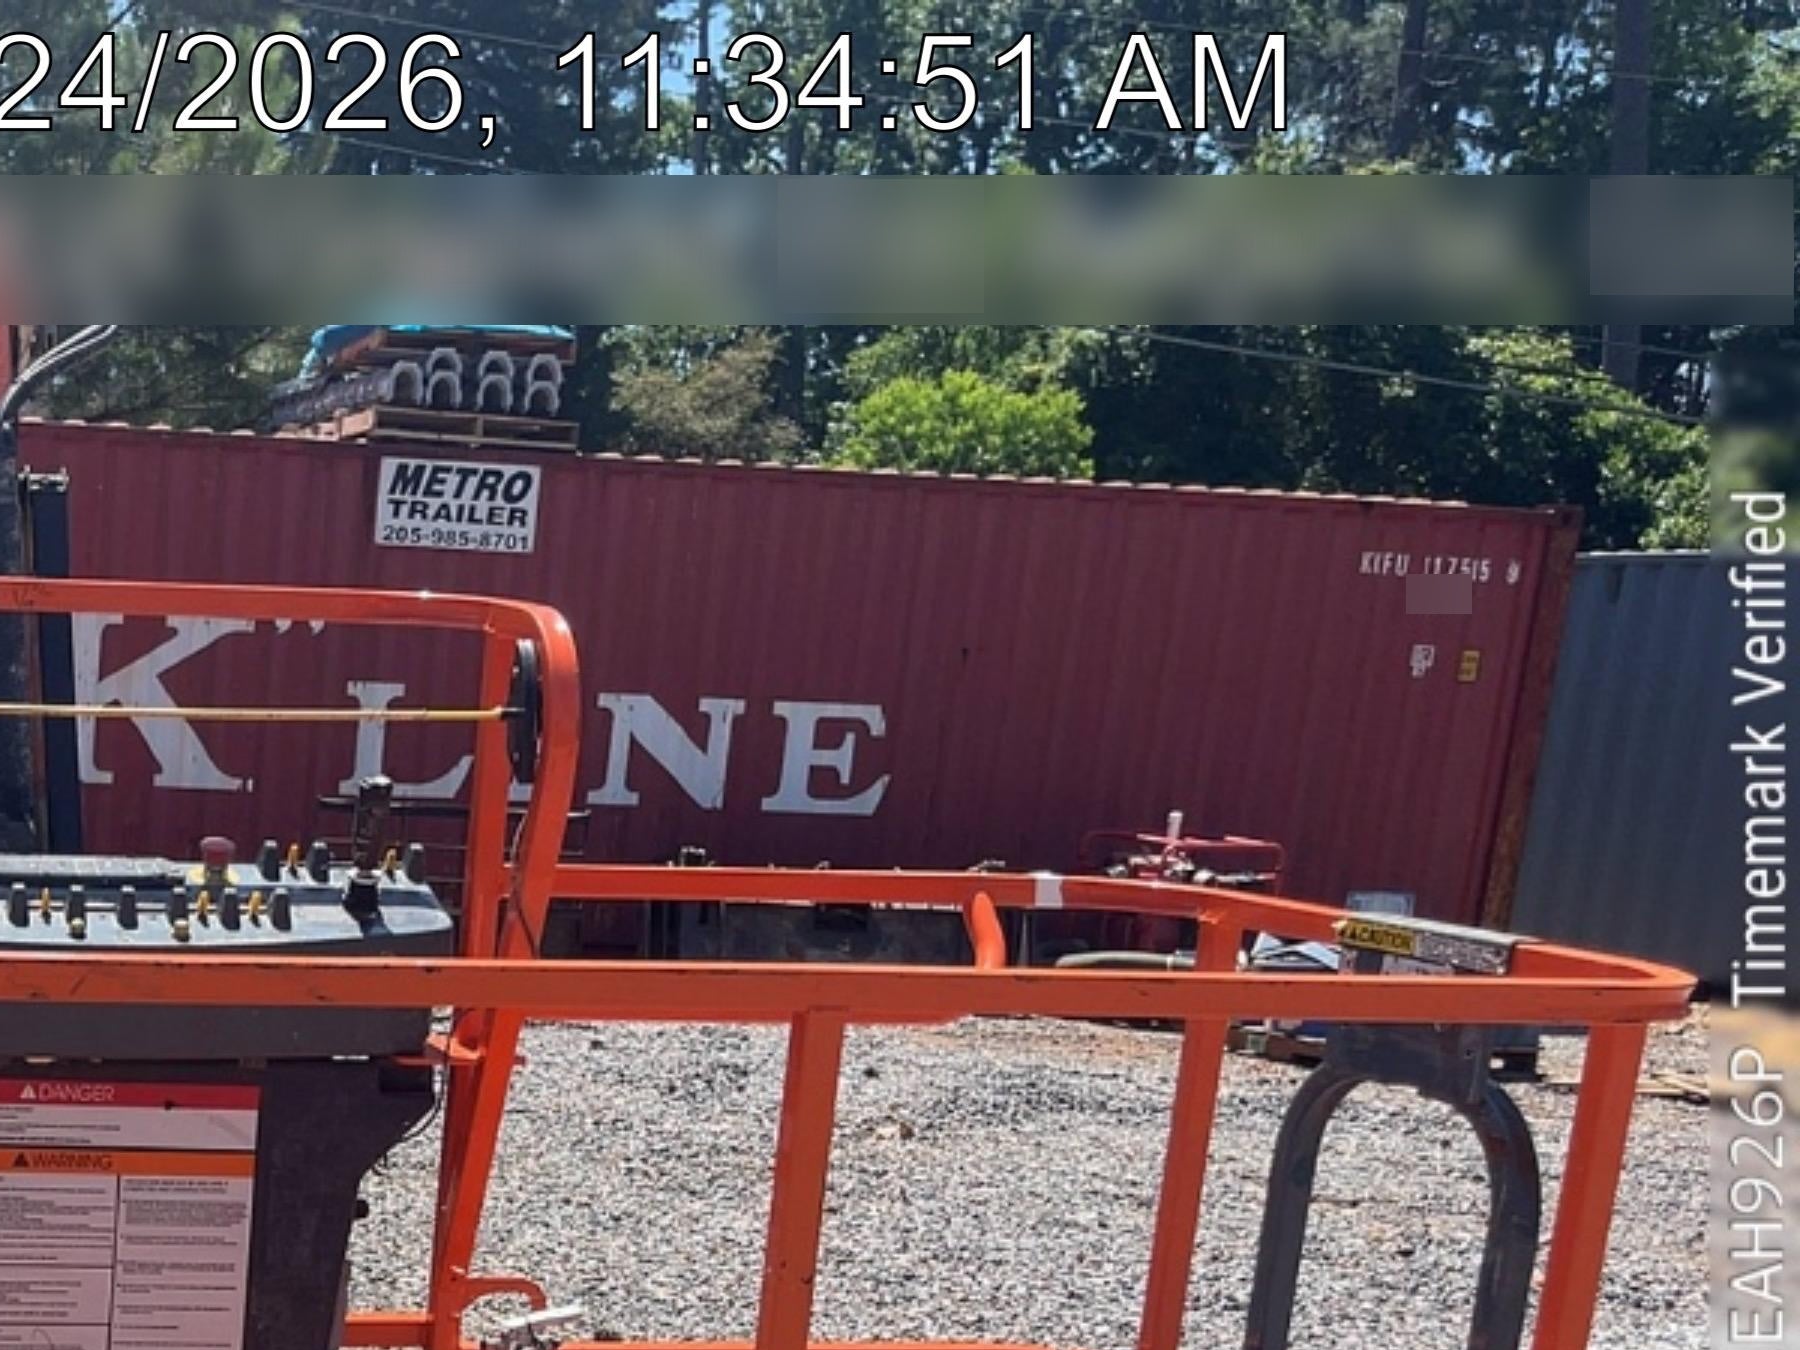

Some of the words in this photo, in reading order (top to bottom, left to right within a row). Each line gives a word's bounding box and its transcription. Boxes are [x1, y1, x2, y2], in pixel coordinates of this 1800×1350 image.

[388, 462, 533, 504] METRO
[387, 499, 528, 527] TRAILER
[383, 525, 529, 549] 205-985-8701
[337, 679, 893, 817] LNE
[38, 1084, 115, 1102] DANGER
[31, 1151, 113, 1170] WARNING
